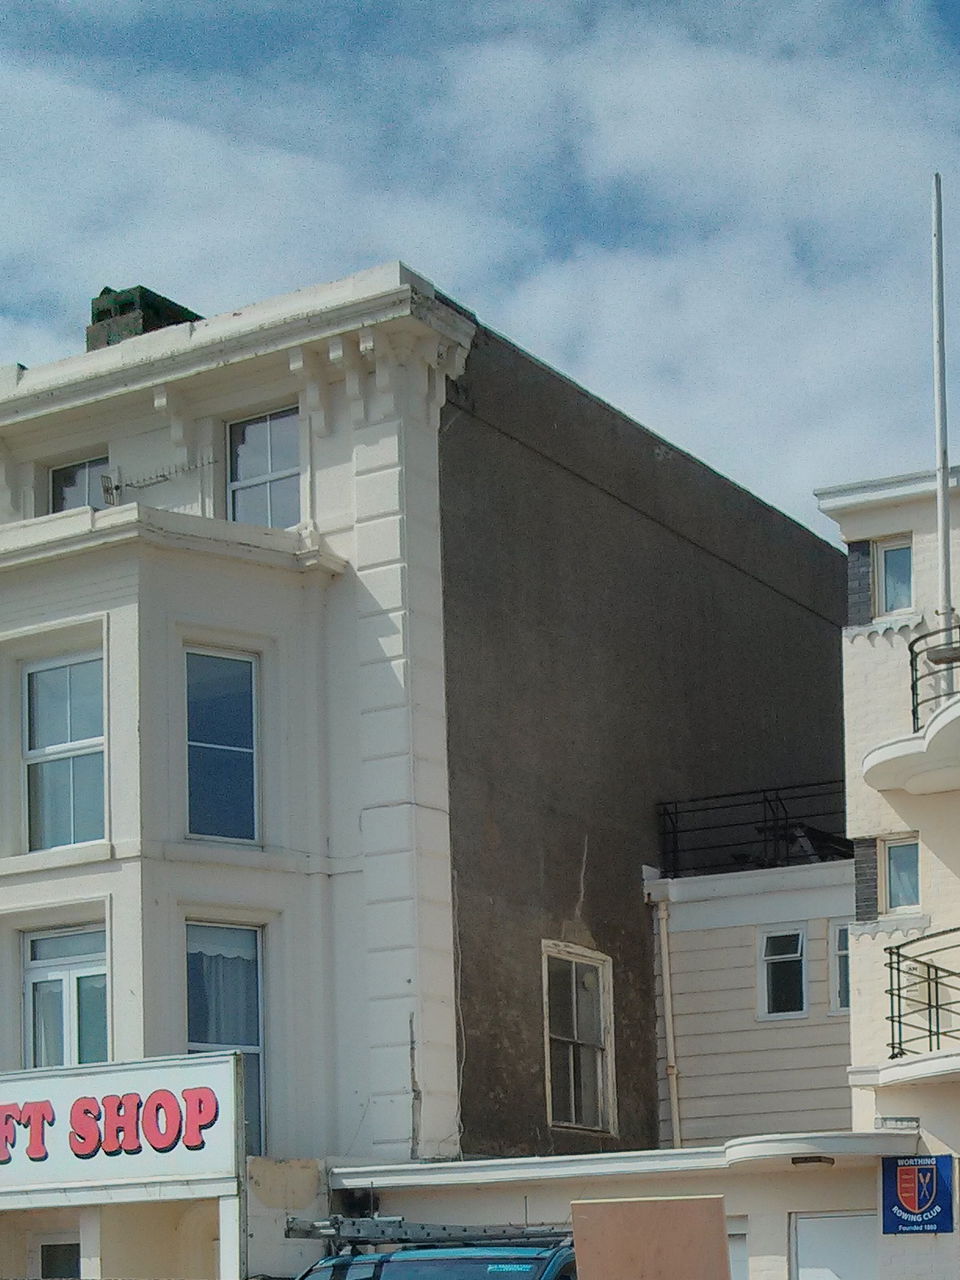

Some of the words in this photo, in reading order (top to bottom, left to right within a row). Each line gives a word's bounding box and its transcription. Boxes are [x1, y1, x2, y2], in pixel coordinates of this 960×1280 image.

[68, 1086, 219, 1160] SHOP
[897, 1157, 937, 1167] WORTHING
[891, 1205, 923, 1222] ROWING
[922, 1204, 942, 1221] CLUB
